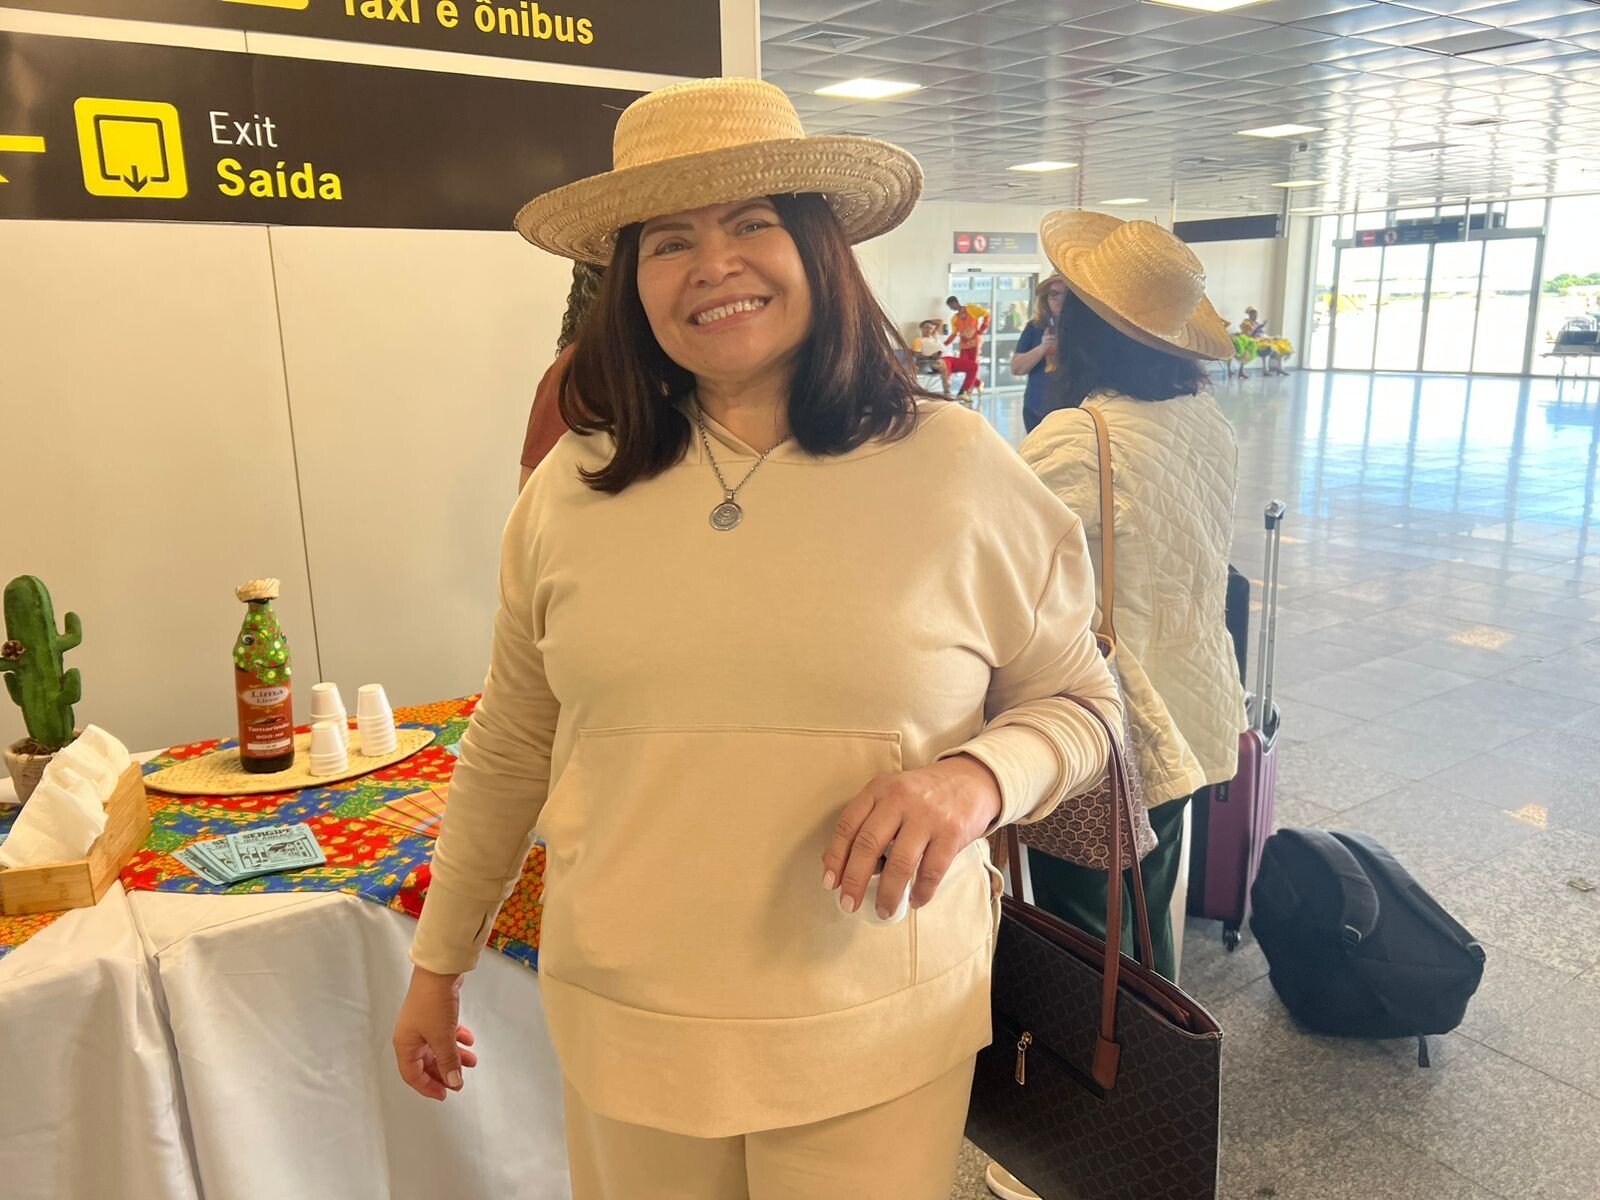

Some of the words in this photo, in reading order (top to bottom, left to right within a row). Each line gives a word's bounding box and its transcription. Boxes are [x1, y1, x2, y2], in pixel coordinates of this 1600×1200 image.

[436, 0, 459, 28] e
[474, 0, 594, 45] ônibus
[209, 111, 278, 148] Exit
[217, 158, 342, 200] Saída
[251, 689, 283, 698] Lima
[248, 722, 290, 732] Tamarindo
